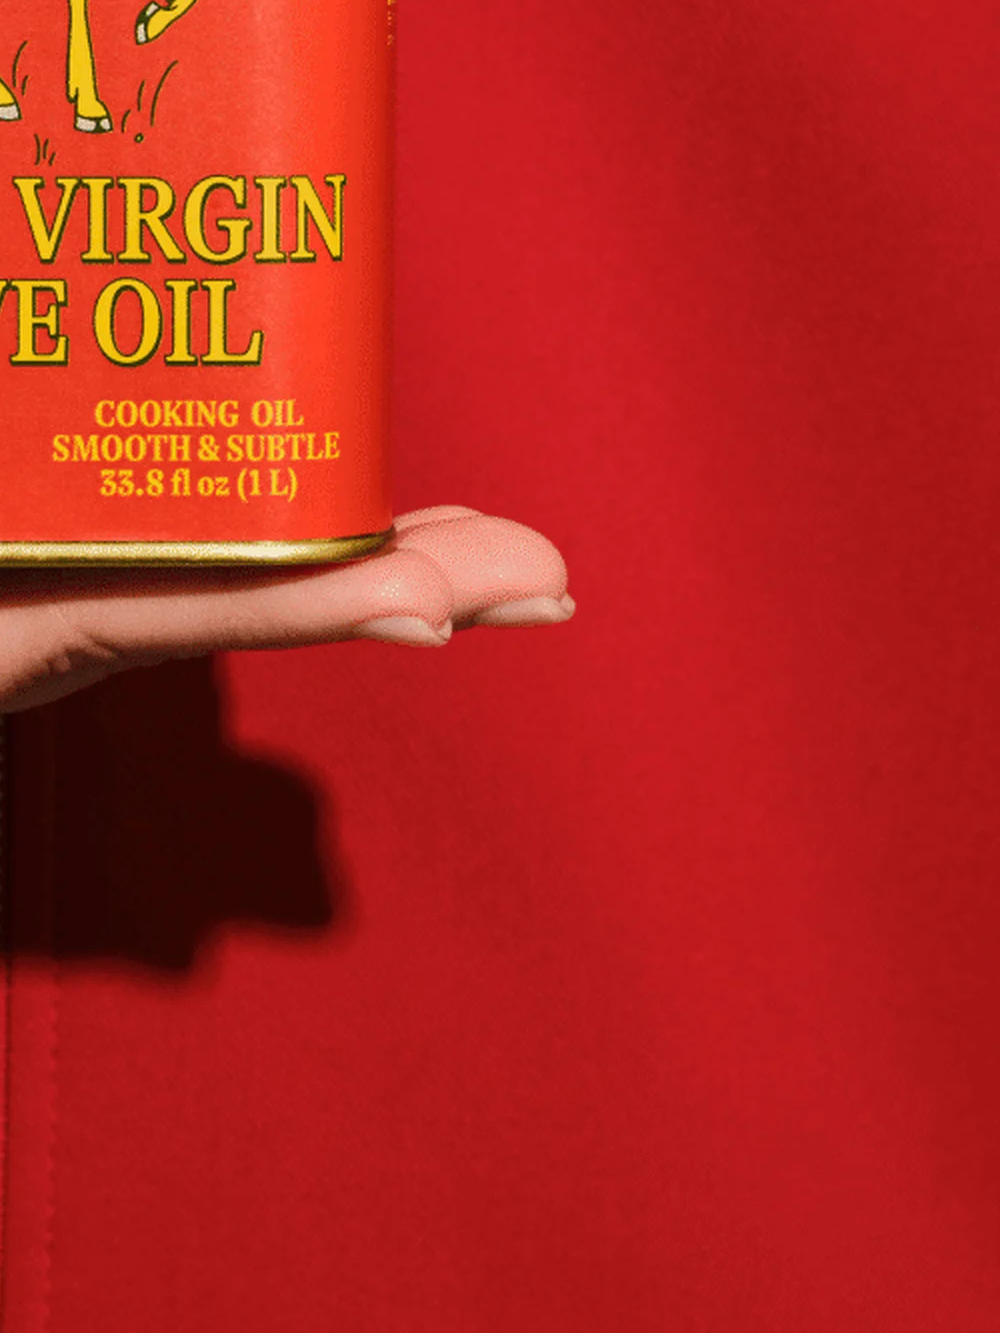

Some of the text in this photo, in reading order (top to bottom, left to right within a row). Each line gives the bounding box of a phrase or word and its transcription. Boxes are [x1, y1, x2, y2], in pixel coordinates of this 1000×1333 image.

[13, 173, 346, 265] VIRGIN
[93, 277, 264, 366] OIL
[94, 399, 305, 428] COOKING OIL
[52, 431, 341, 462] SMOOTH & SUBTLE
[100, 468, 165, 497] 33.8
[170, 468, 192, 497] fl
[197, 476, 231, 497] oz
